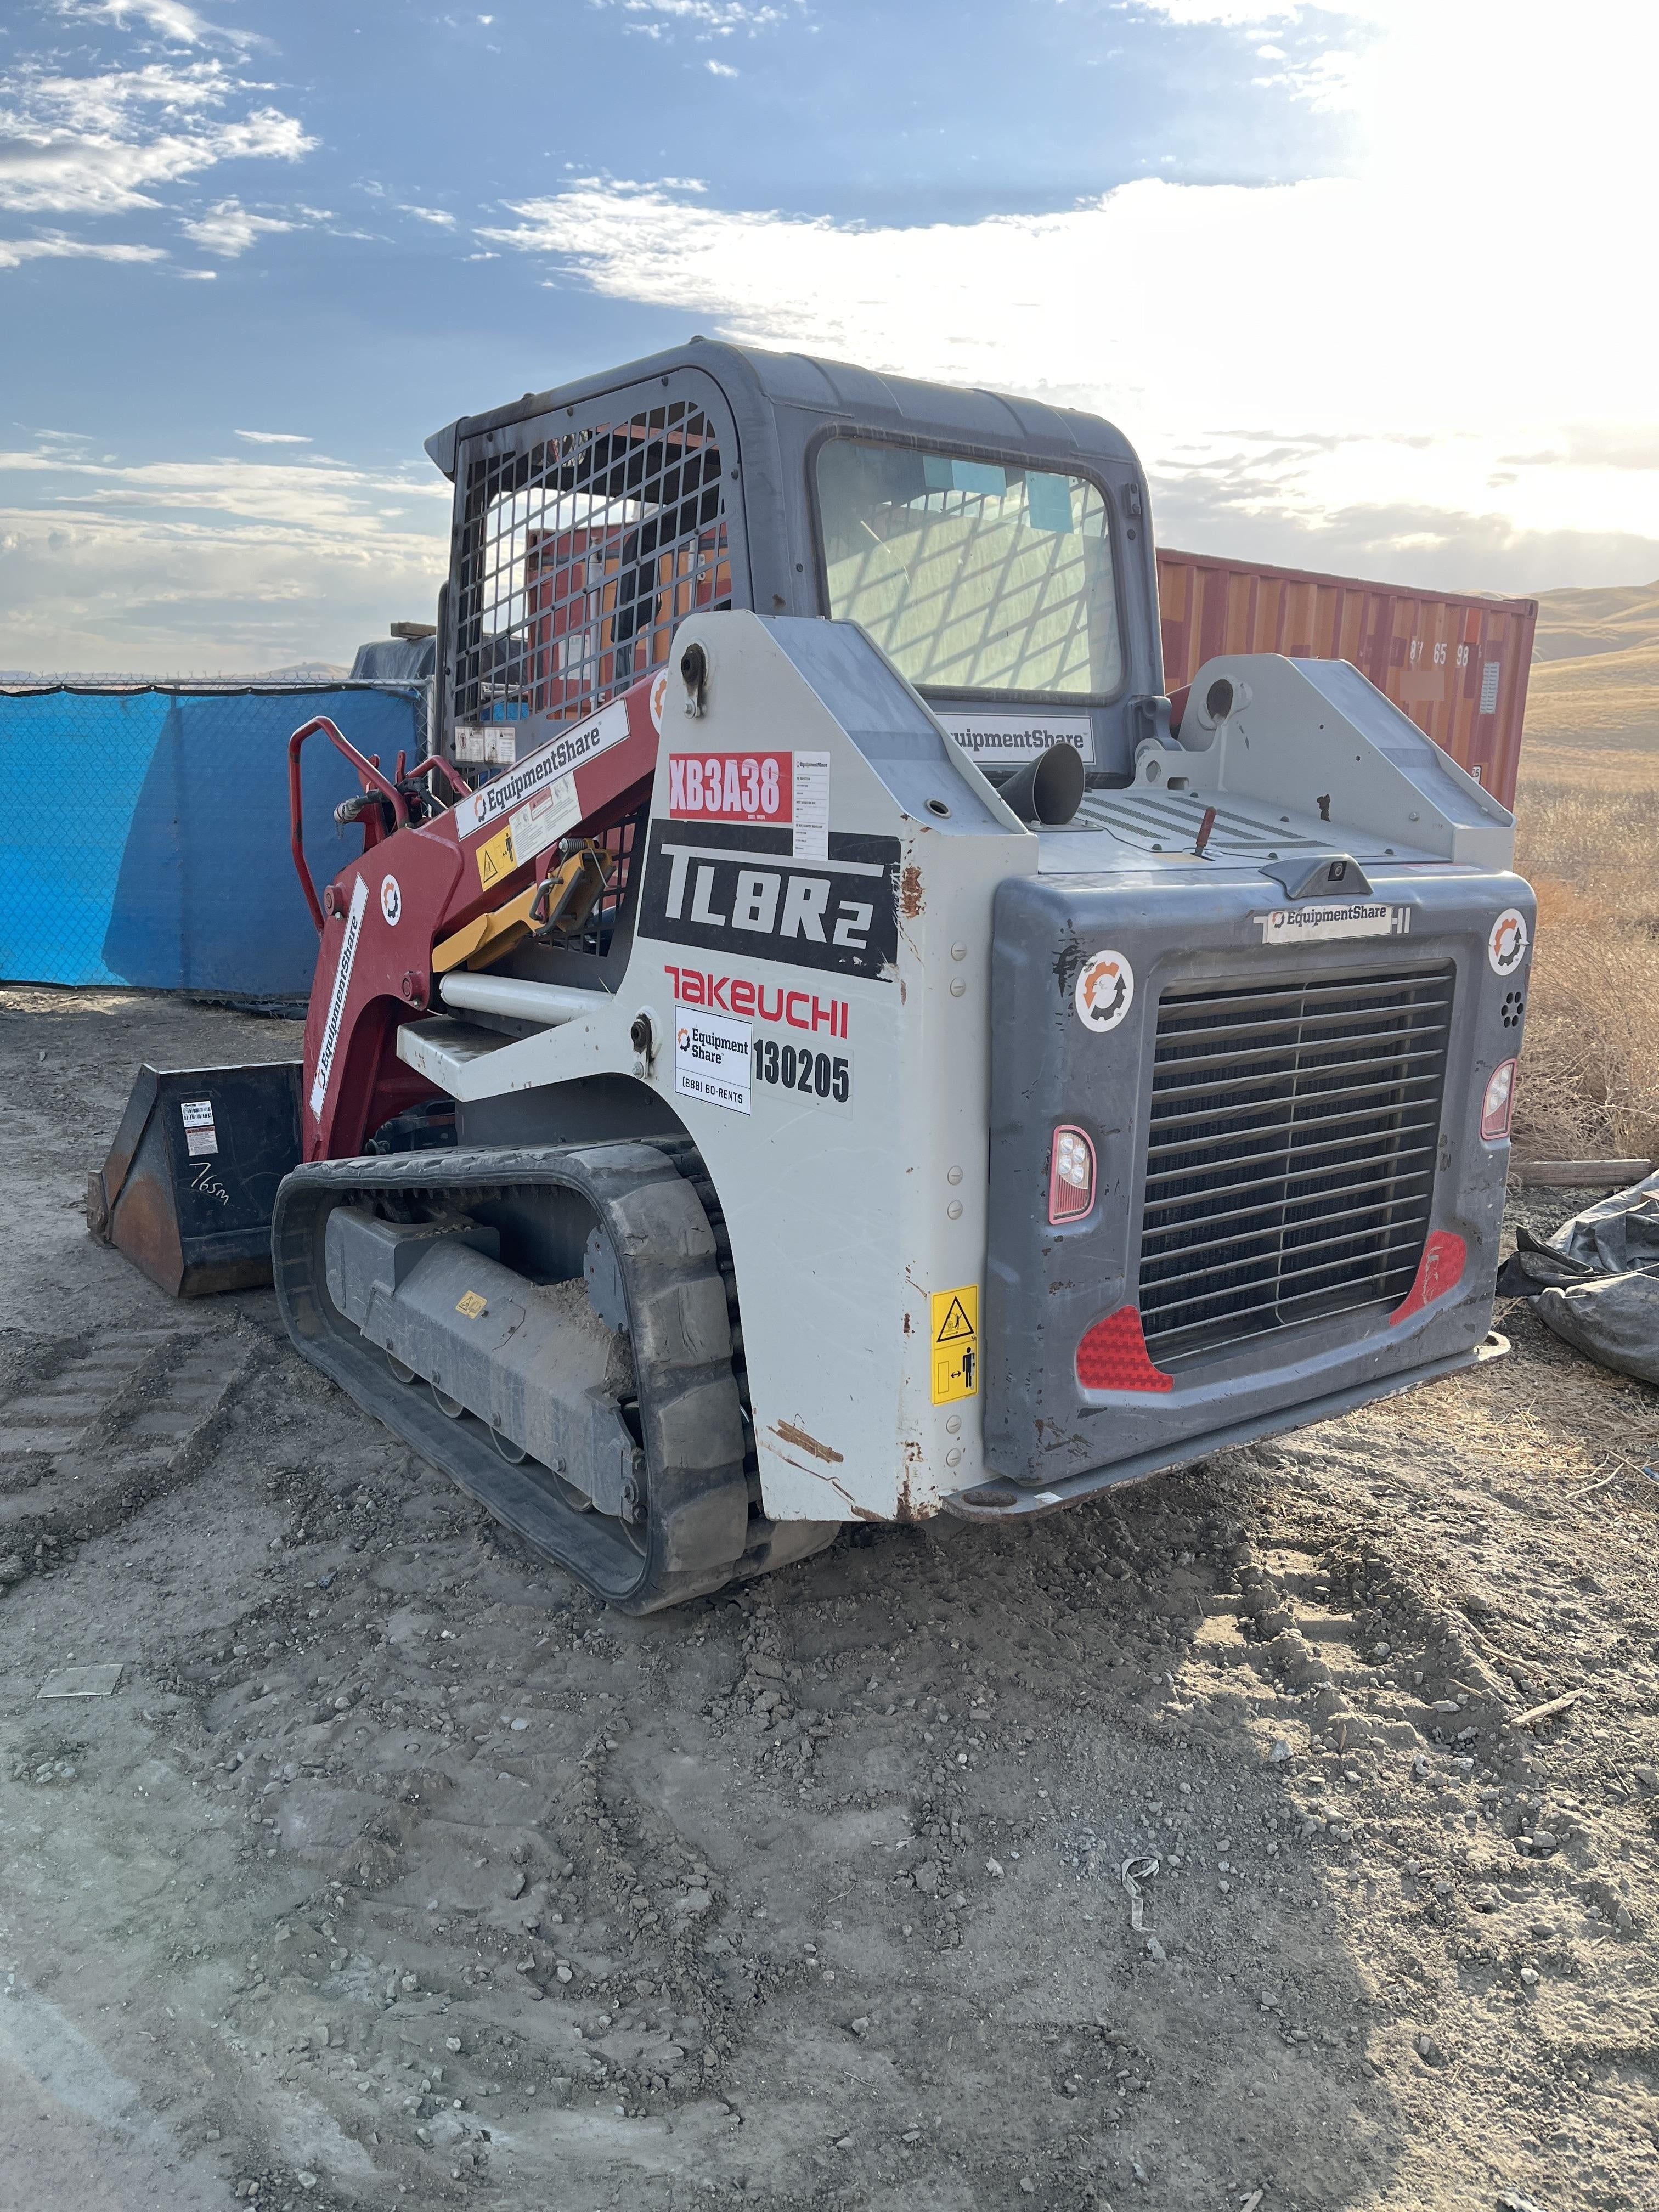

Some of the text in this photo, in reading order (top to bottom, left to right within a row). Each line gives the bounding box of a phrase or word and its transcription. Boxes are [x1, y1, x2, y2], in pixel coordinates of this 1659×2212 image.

[1457, 645, 1469, 667] 98
[950, 729, 1084, 752] uipmentShare
[487, 727, 600, 810] EquipmentShare
[670, 758, 780, 814] XB3A38
[1287, 905, 1386, 927] EquipmentShare
[321, 915, 358, 1069] EquipmentShare
[692, 1028, 749, 1055] Equipment
[692, 1044, 721, 1064] Share
[753, 1039, 849, 1103] 130205
[682, 1076, 743, 1104] (888) 80-RENTS
